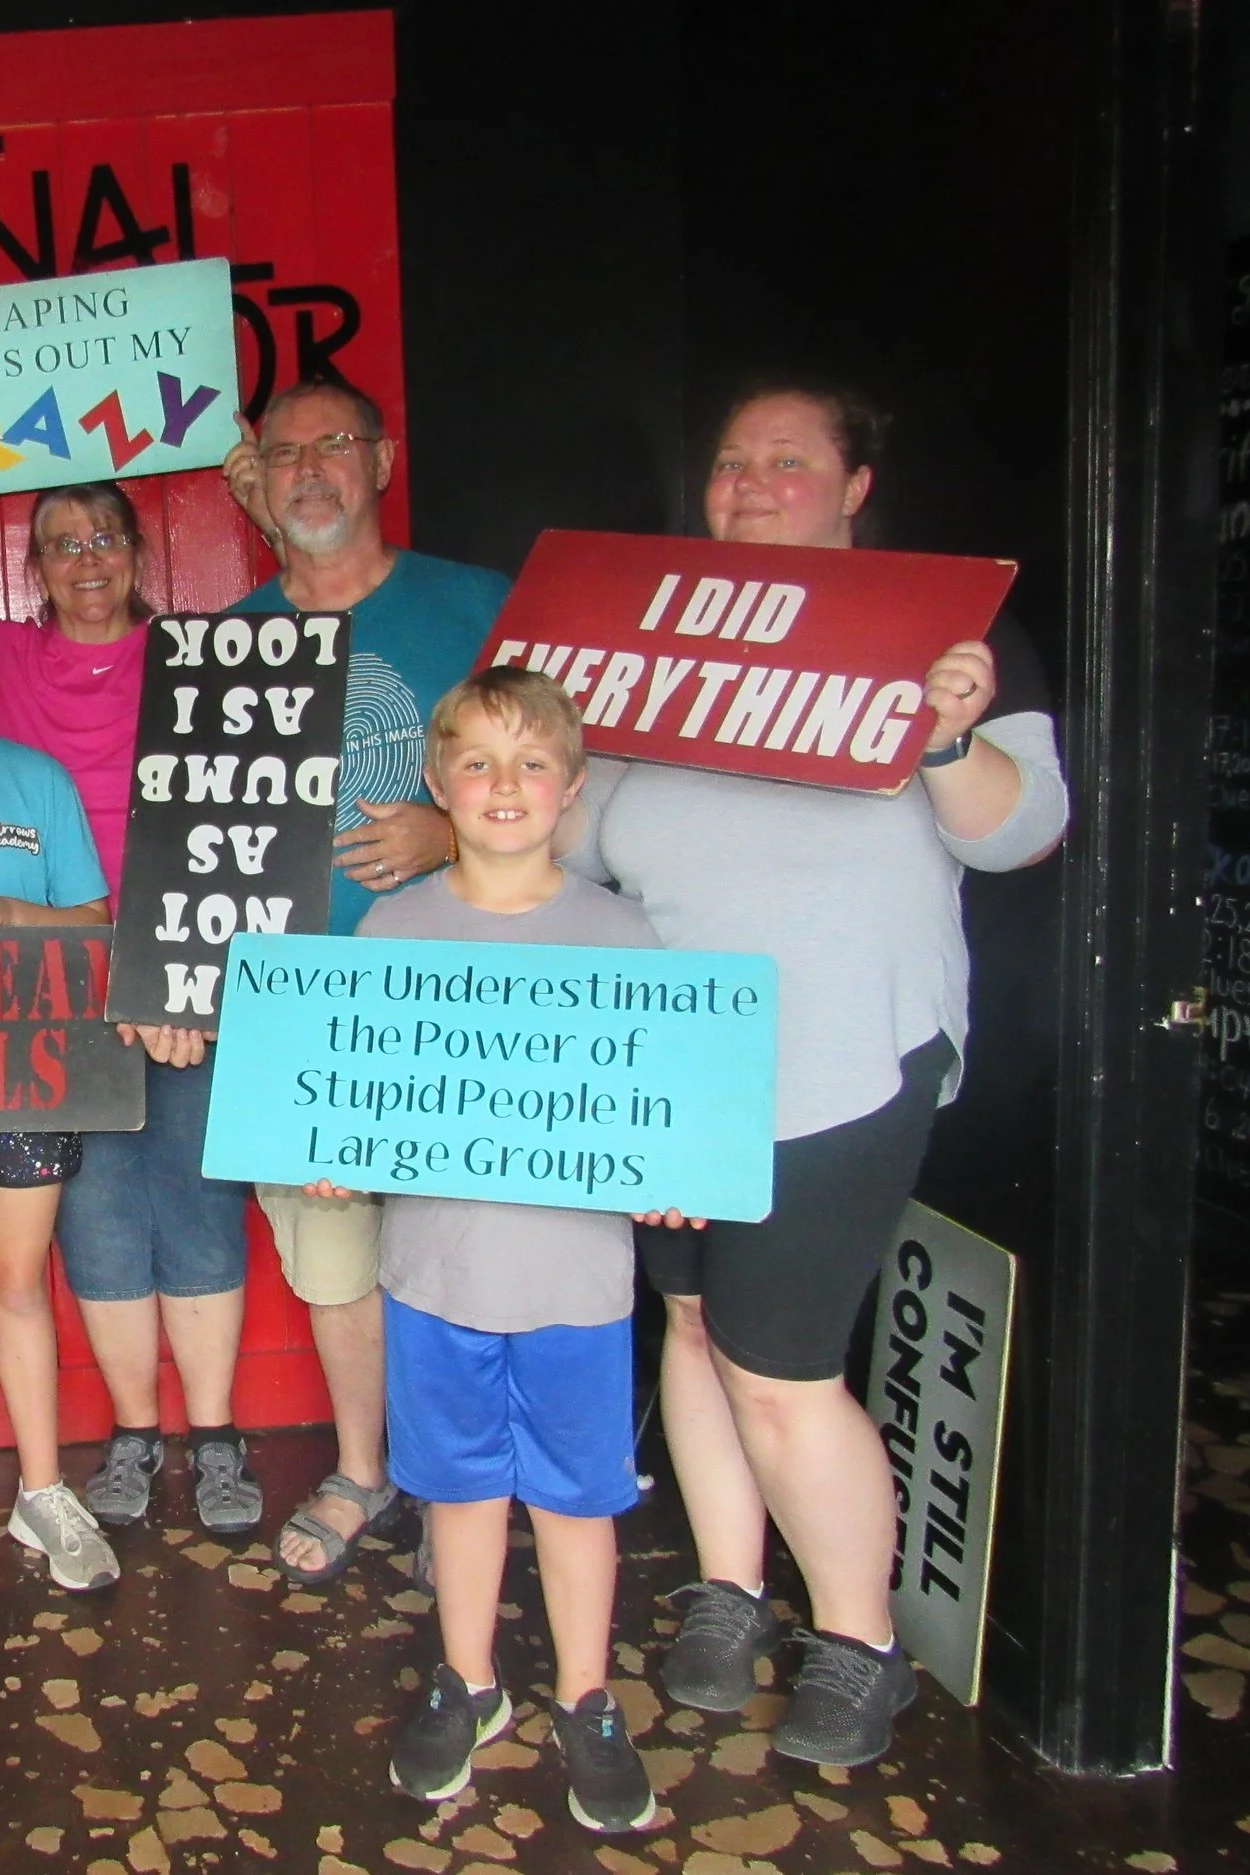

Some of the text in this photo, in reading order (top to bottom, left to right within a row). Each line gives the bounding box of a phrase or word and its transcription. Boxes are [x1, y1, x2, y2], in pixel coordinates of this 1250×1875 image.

[34, 336, 119, 374] OUT
[131, 326, 193, 364] MY
[638, 574, 806, 645] I DID
[160, 617, 341, 667] LOOK
[172, 686, 314, 736] AS I
[346, 725, 425, 753] IN HIS IMAGE
[137, 754, 340, 806] DUMB
[186, 824, 278, 875] AS
[155, 892, 293, 945] NOT
[236, 959, 760, 1017] Never Underestimate
[326, 1015, 648, 1068] the Power of
[293, 1069, 673, 1132] Stupid People in
[307, 1126, 646, 1195] Large Groups
[878, 1239, 933, 1592] CONFU
[920, 1290, 986, 1602] I'M STILL
